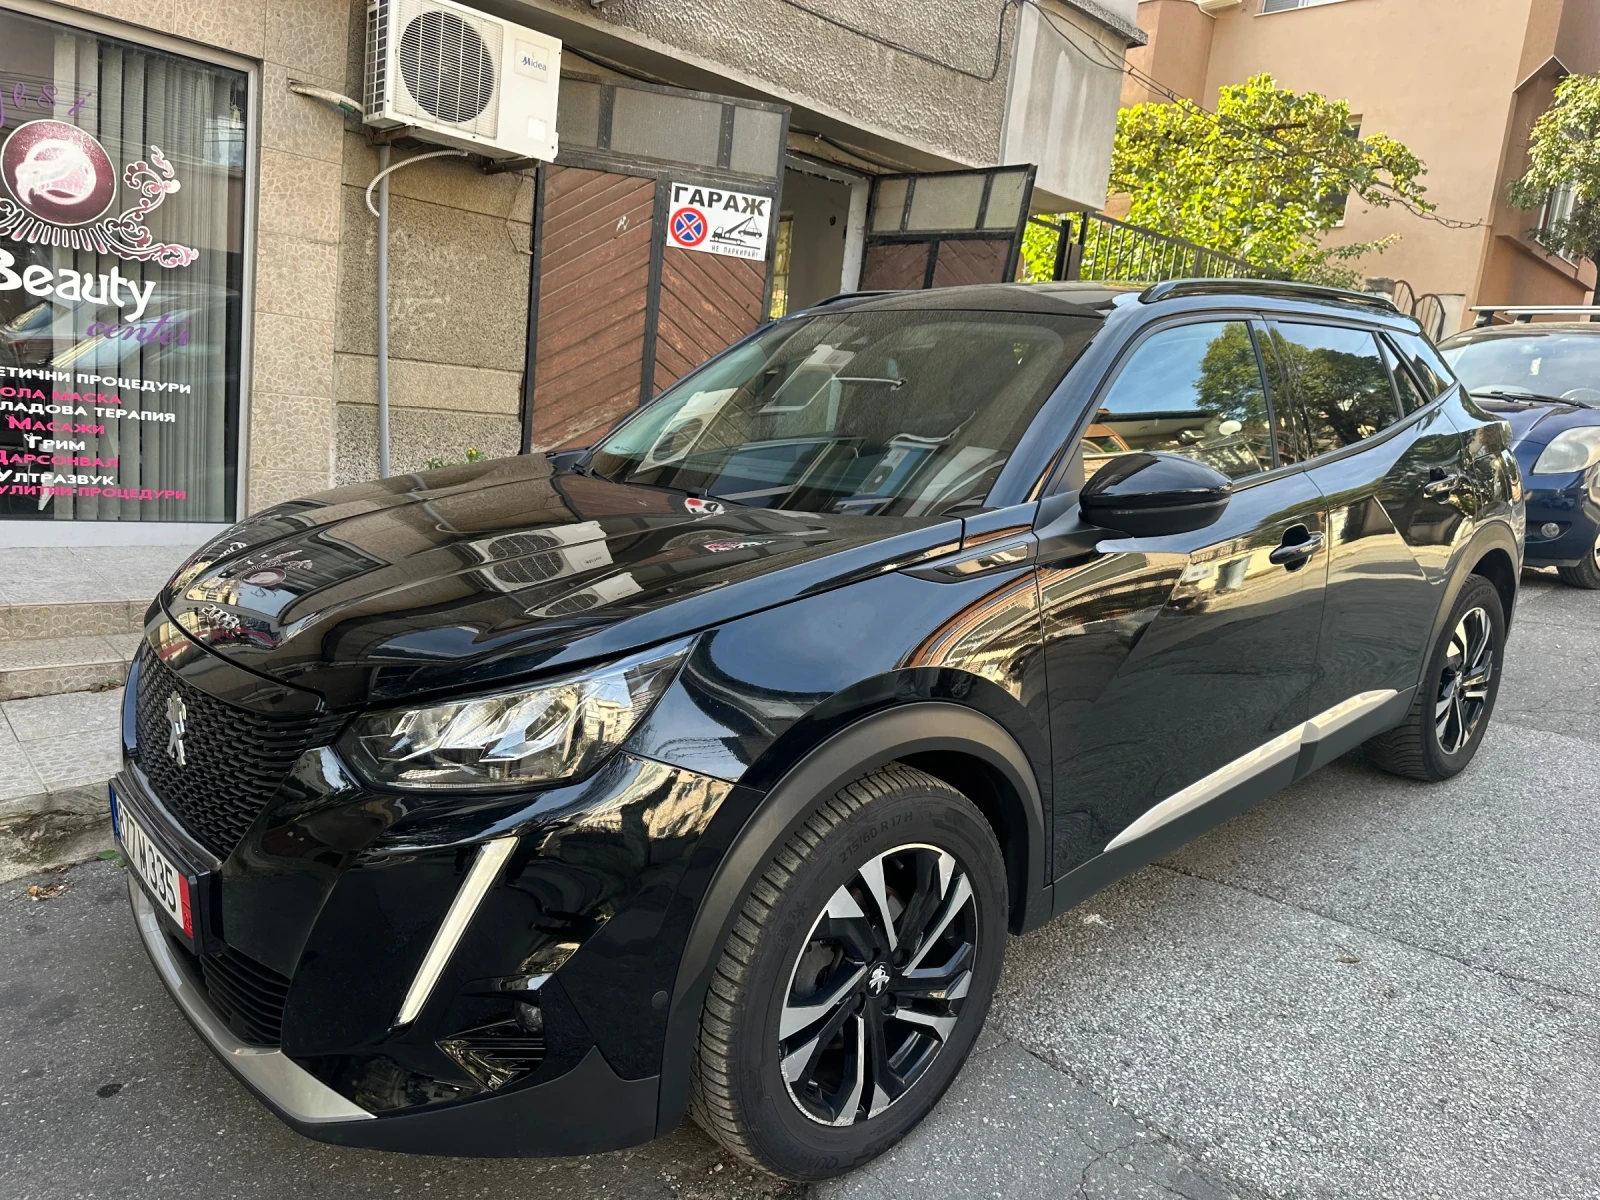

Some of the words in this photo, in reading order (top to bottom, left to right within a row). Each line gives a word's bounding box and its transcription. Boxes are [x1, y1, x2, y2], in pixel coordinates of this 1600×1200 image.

[521, 56, 547, 71] Midea
[673, 185, 766, 217] ГАРАЖ
[711, 245, 719, 253] НЕ
[723, 246, 759, 259] ПАРКИРАЙ!
[0, 247, 156, 322] Beauty
[86, 314, 193, 347] center
[76, 373, 191, 394] ПРОЦЕДУРИ
[0, 386, 46, 400] ОЛА
[52, 391, 122, 405] МАСКА
[0, 401, 87, 417] ЛАДОВА
[94, 407, 176, 423] ТЕРАПИЯ
[78, 486, 187, 501] ПРОЦЕДУРИ
[838, 827, 878, 865] 215/60
